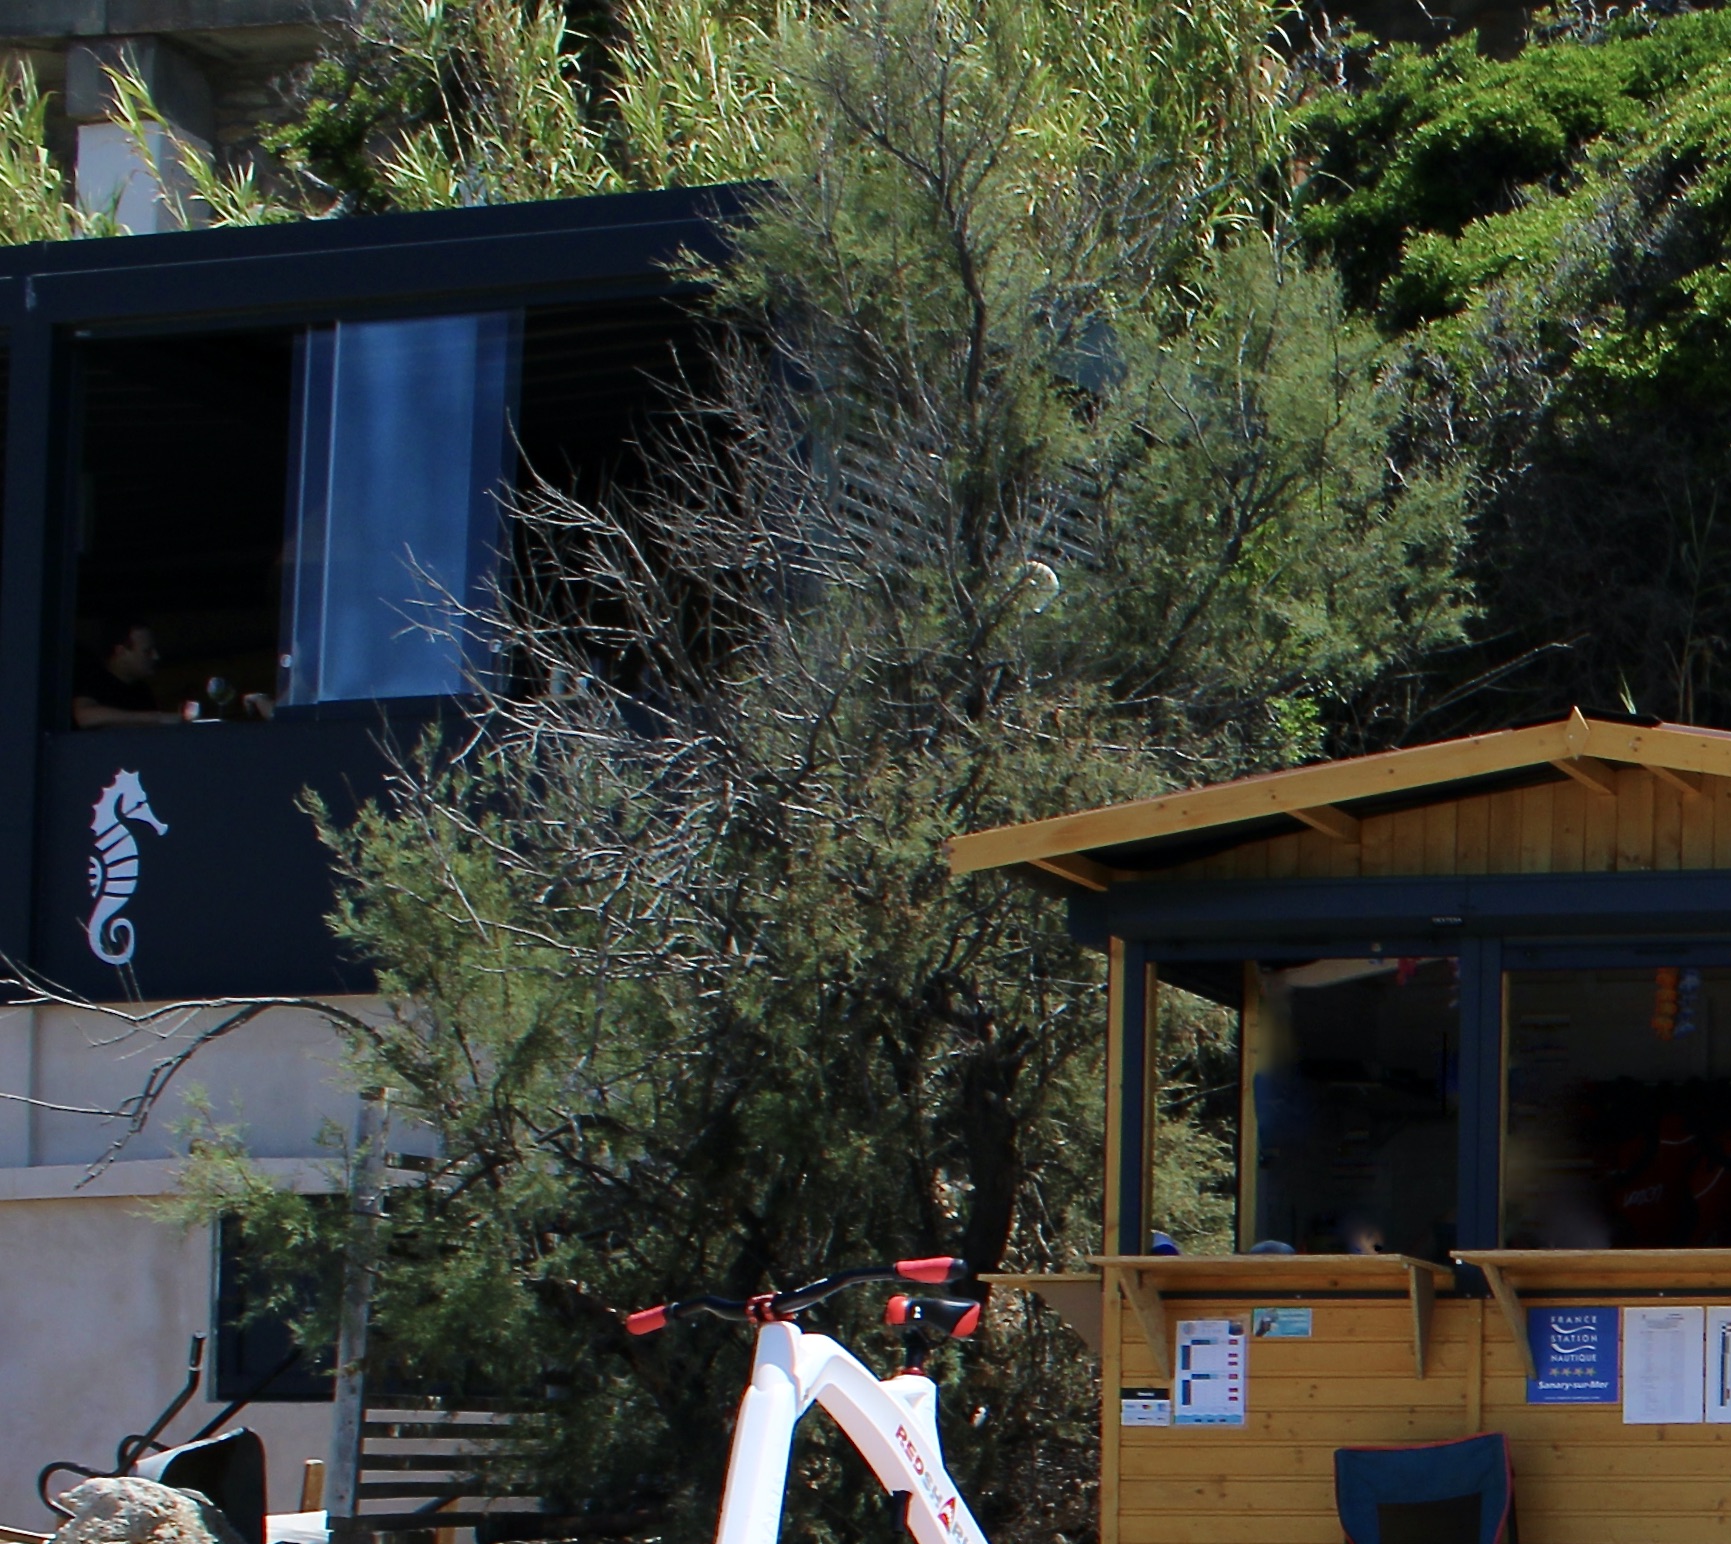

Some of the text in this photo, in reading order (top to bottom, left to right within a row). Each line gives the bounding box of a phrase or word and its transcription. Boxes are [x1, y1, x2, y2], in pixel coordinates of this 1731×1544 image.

[1550, 1315, 1597, 1324] FRANCE
[1550, 1334, 1598, 1342] STATION
[1550, 1354, 1597, 1363] NAUTIQUE
[1538, 1380, 1609, 1391] Sanary-sur-Mer
